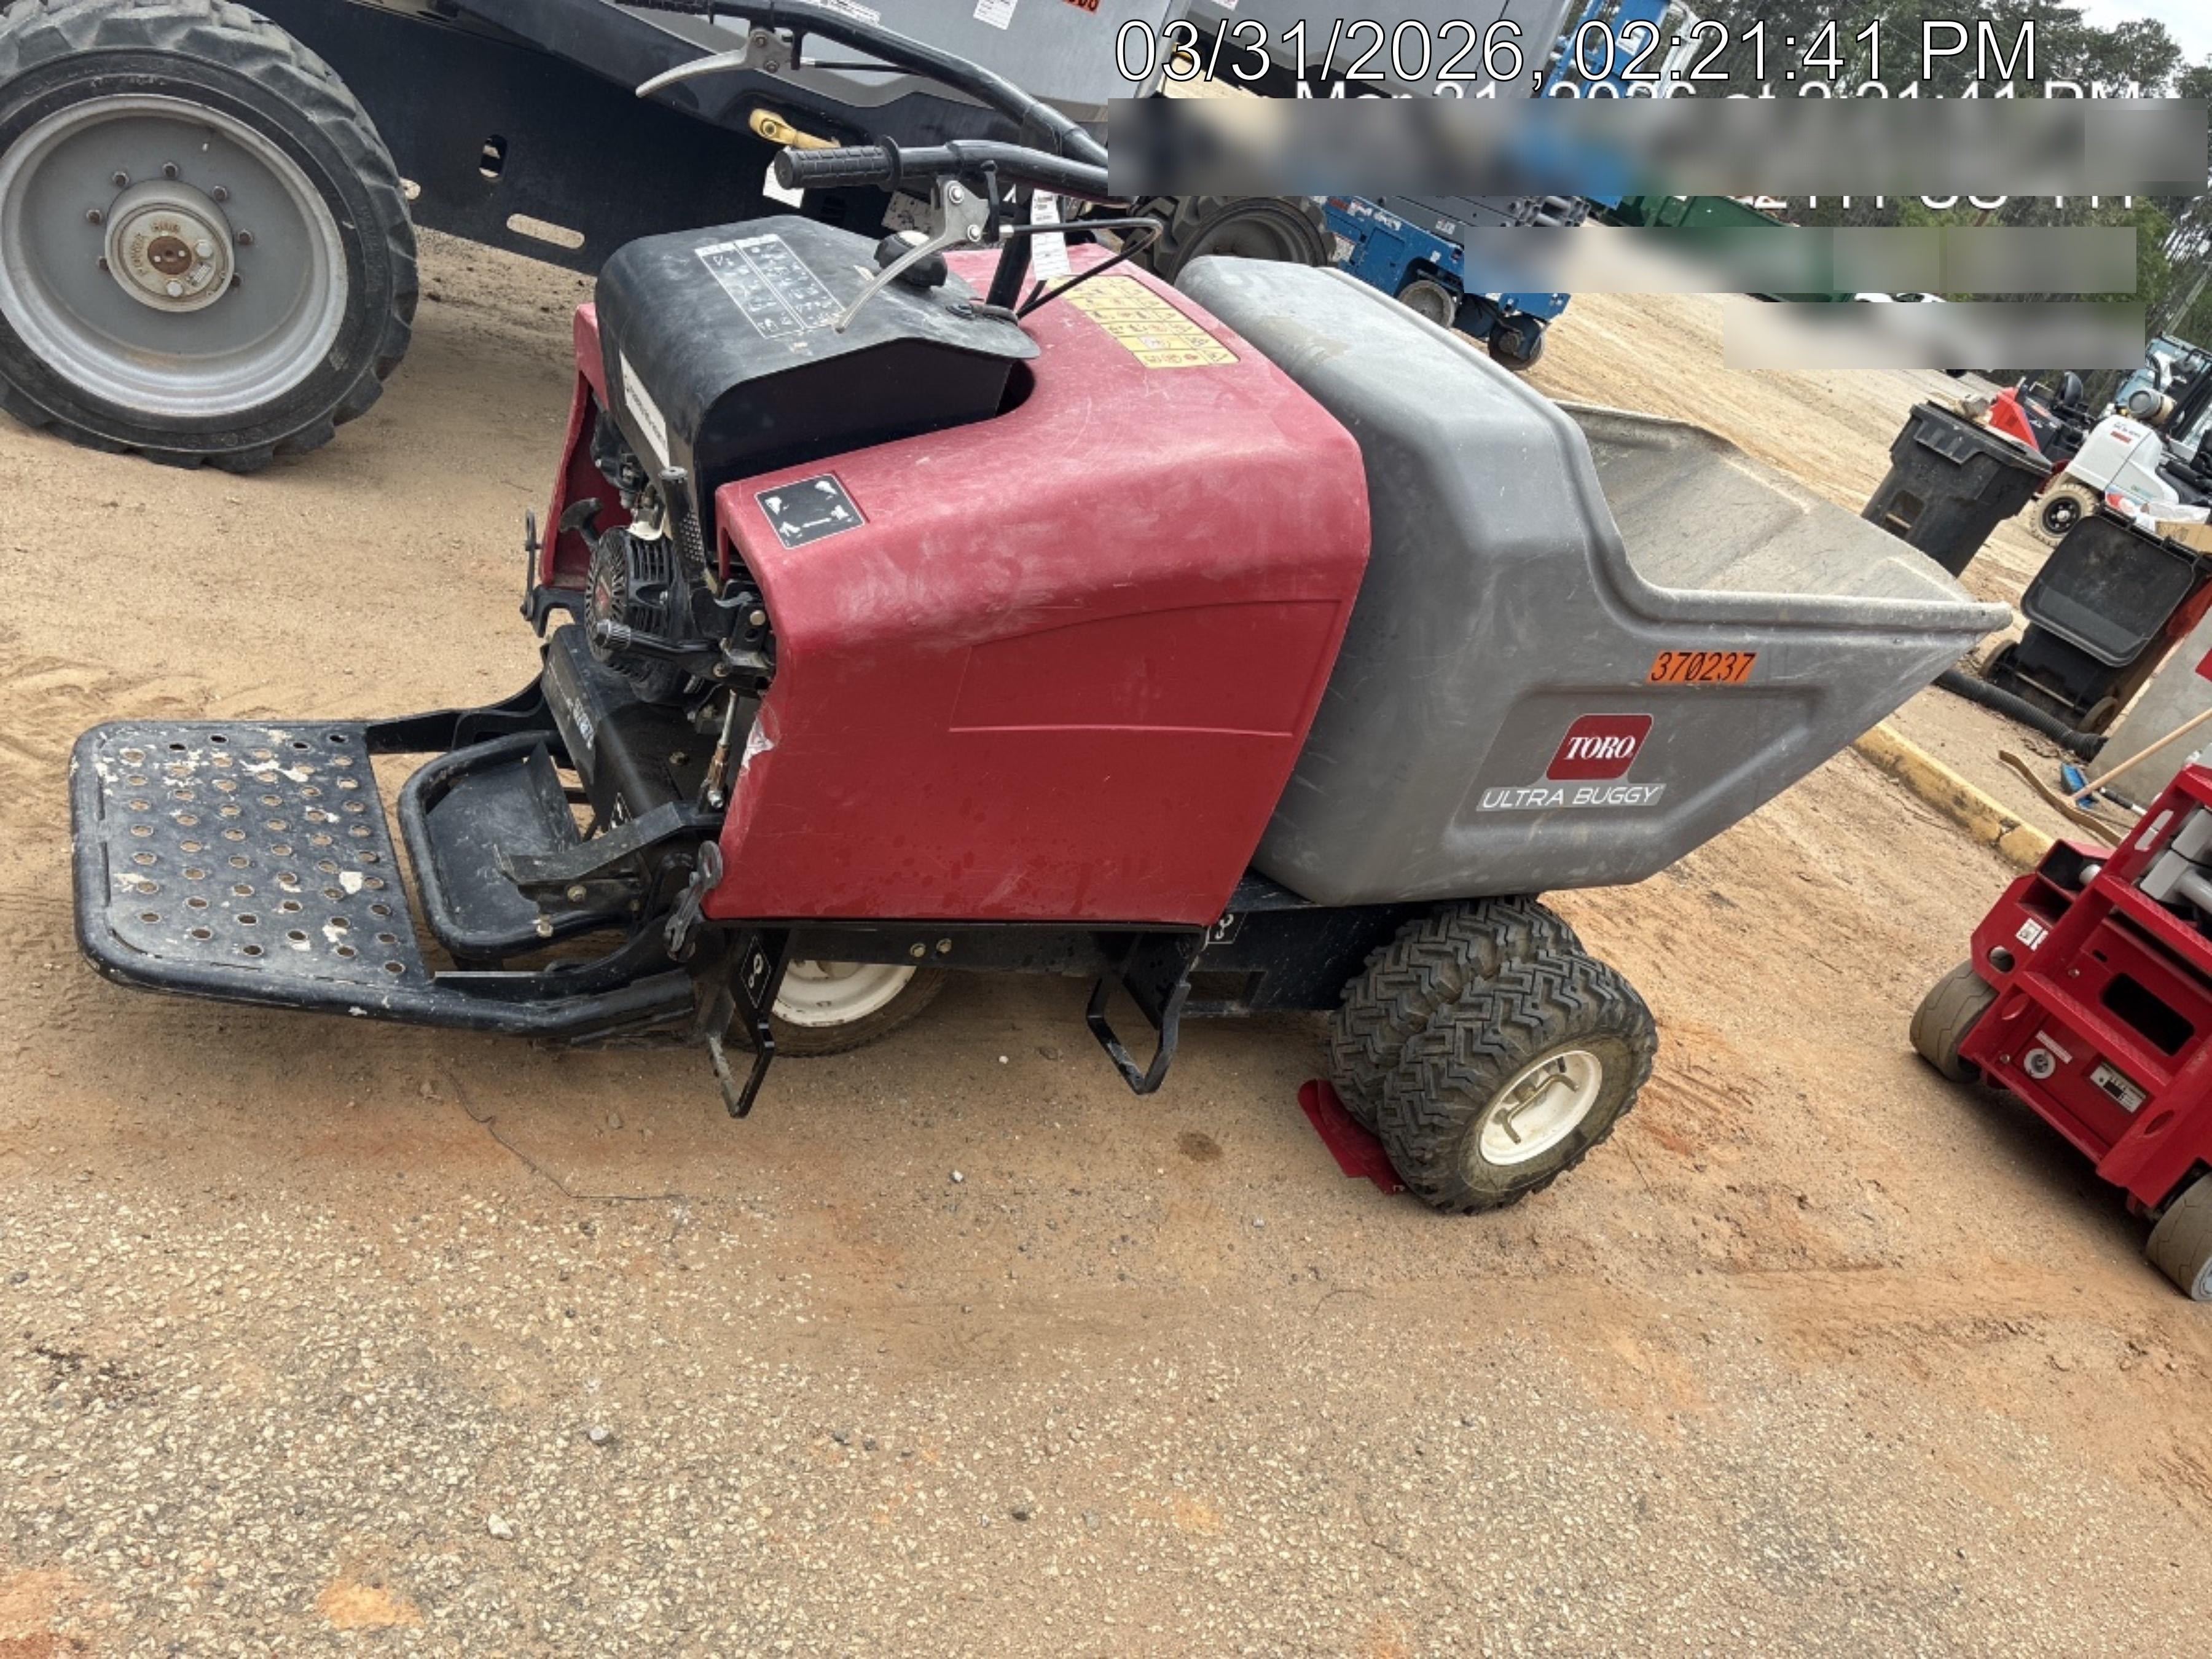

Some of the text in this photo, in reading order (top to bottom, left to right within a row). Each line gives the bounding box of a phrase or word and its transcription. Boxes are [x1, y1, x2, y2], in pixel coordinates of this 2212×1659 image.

[1650, 651, 1757, 681] 370237
[1564, 735, 1636, 761] TORO
[1483, 785, 1660, 809] ULTRA BUGGY
